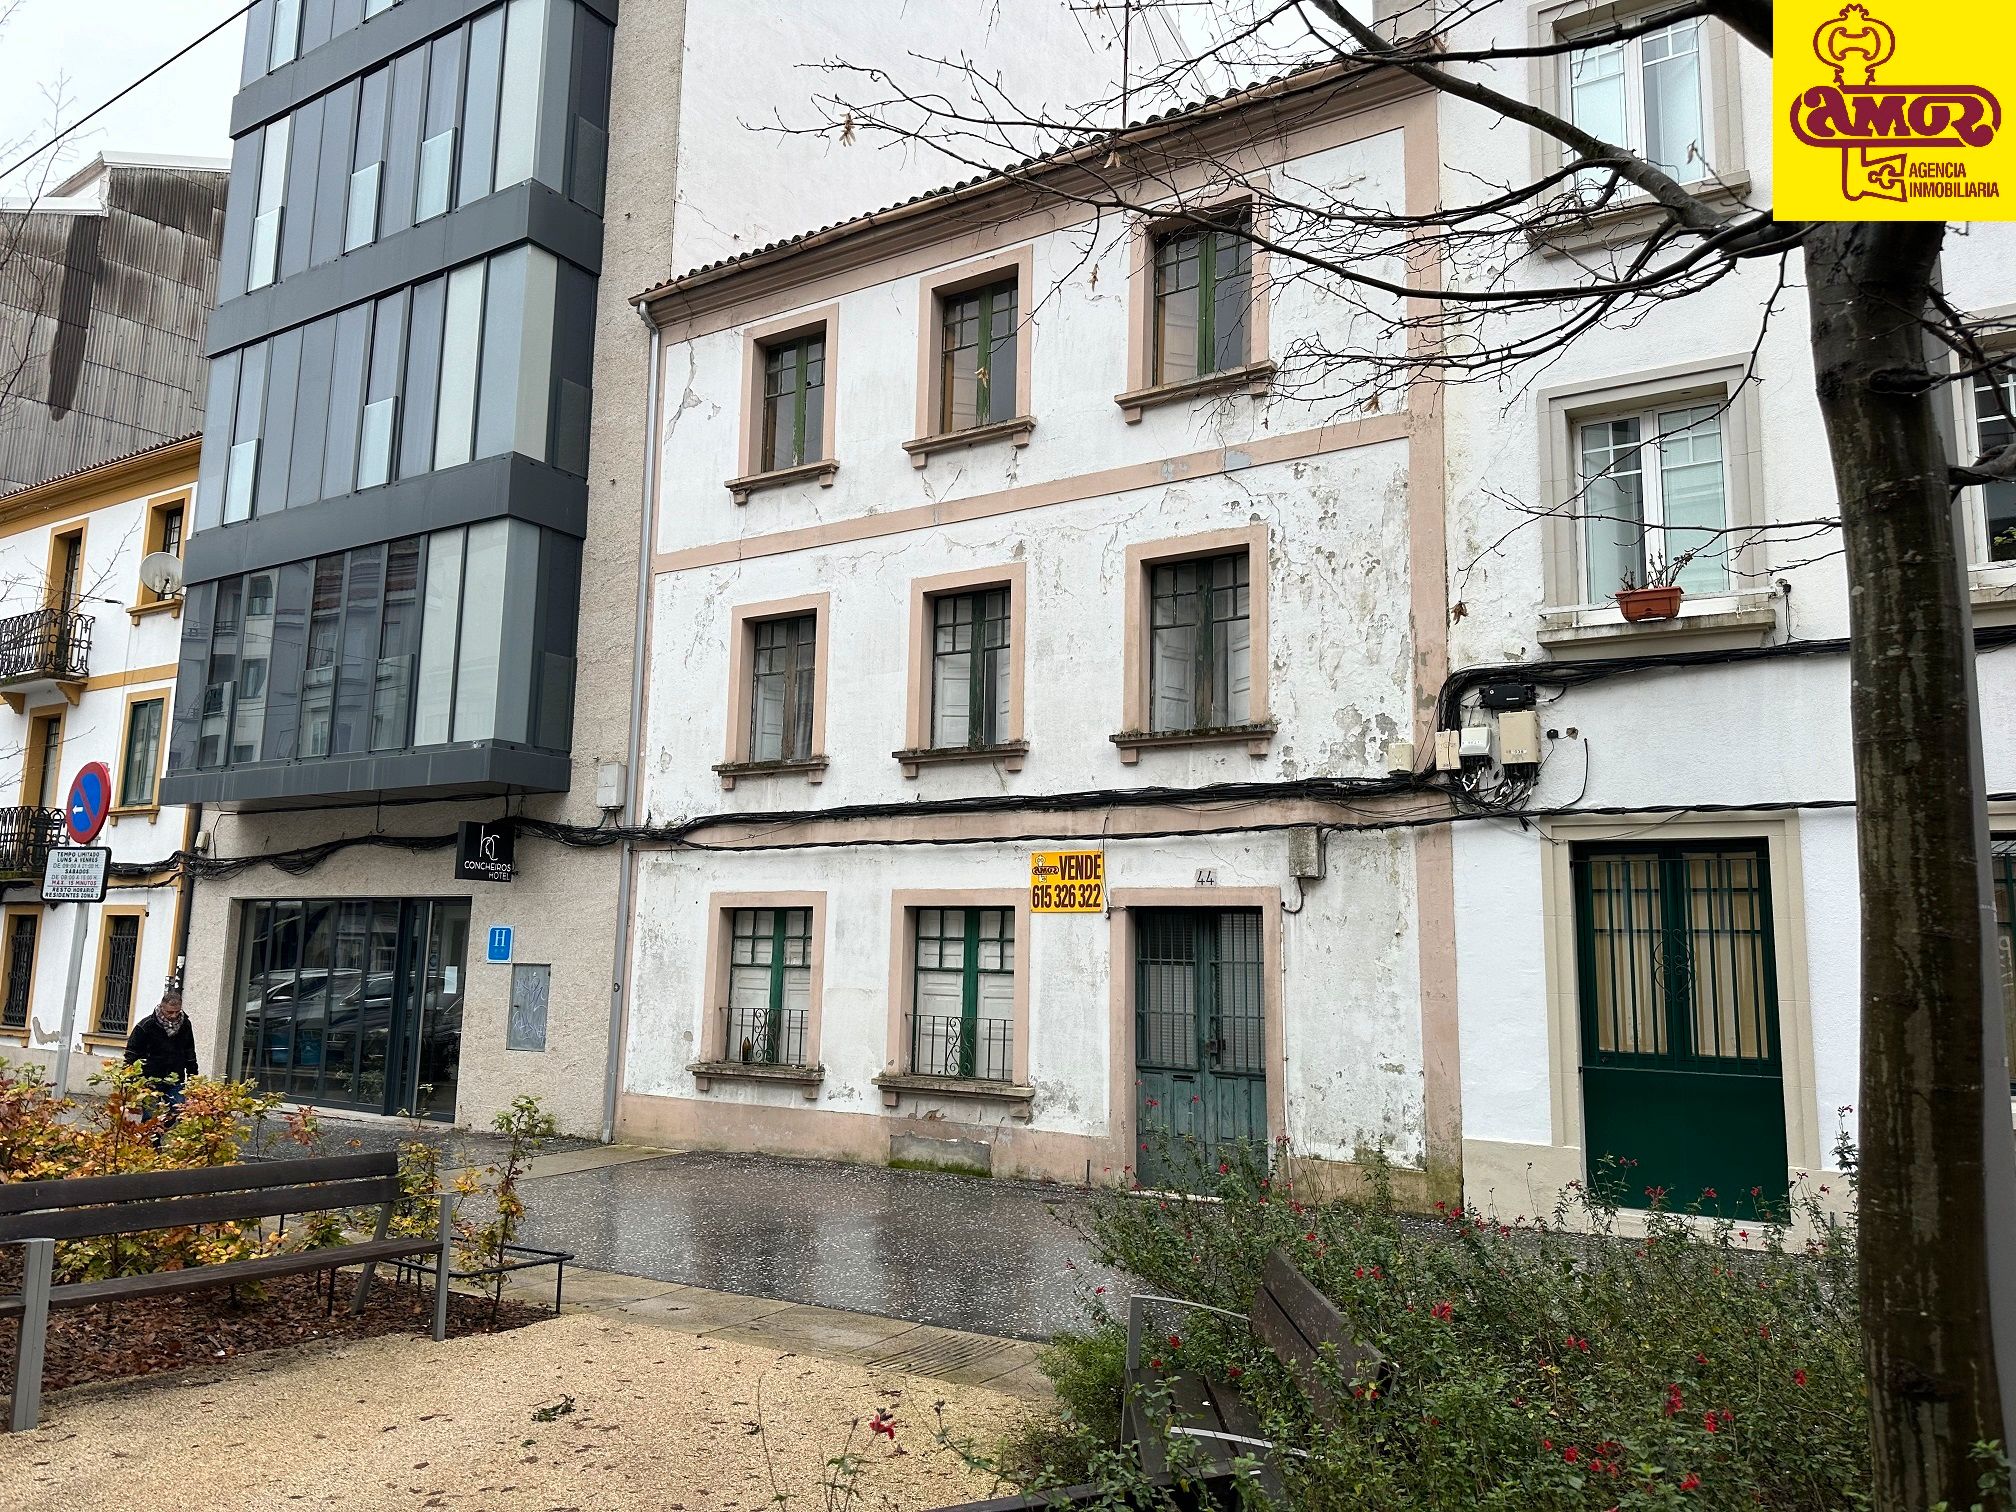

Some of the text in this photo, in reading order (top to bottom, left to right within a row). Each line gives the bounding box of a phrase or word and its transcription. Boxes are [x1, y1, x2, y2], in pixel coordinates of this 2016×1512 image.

[464, 861, 511, 872] CONCHEIROS
[1059, 854, 1102, 880] VENDE
[489, 872, 510, 880] HOTEL
[1197, 870, 1215, 886] 44
[1032, 884, 1101, 908] 615 326 322
[494, 929, 507, 947] H
